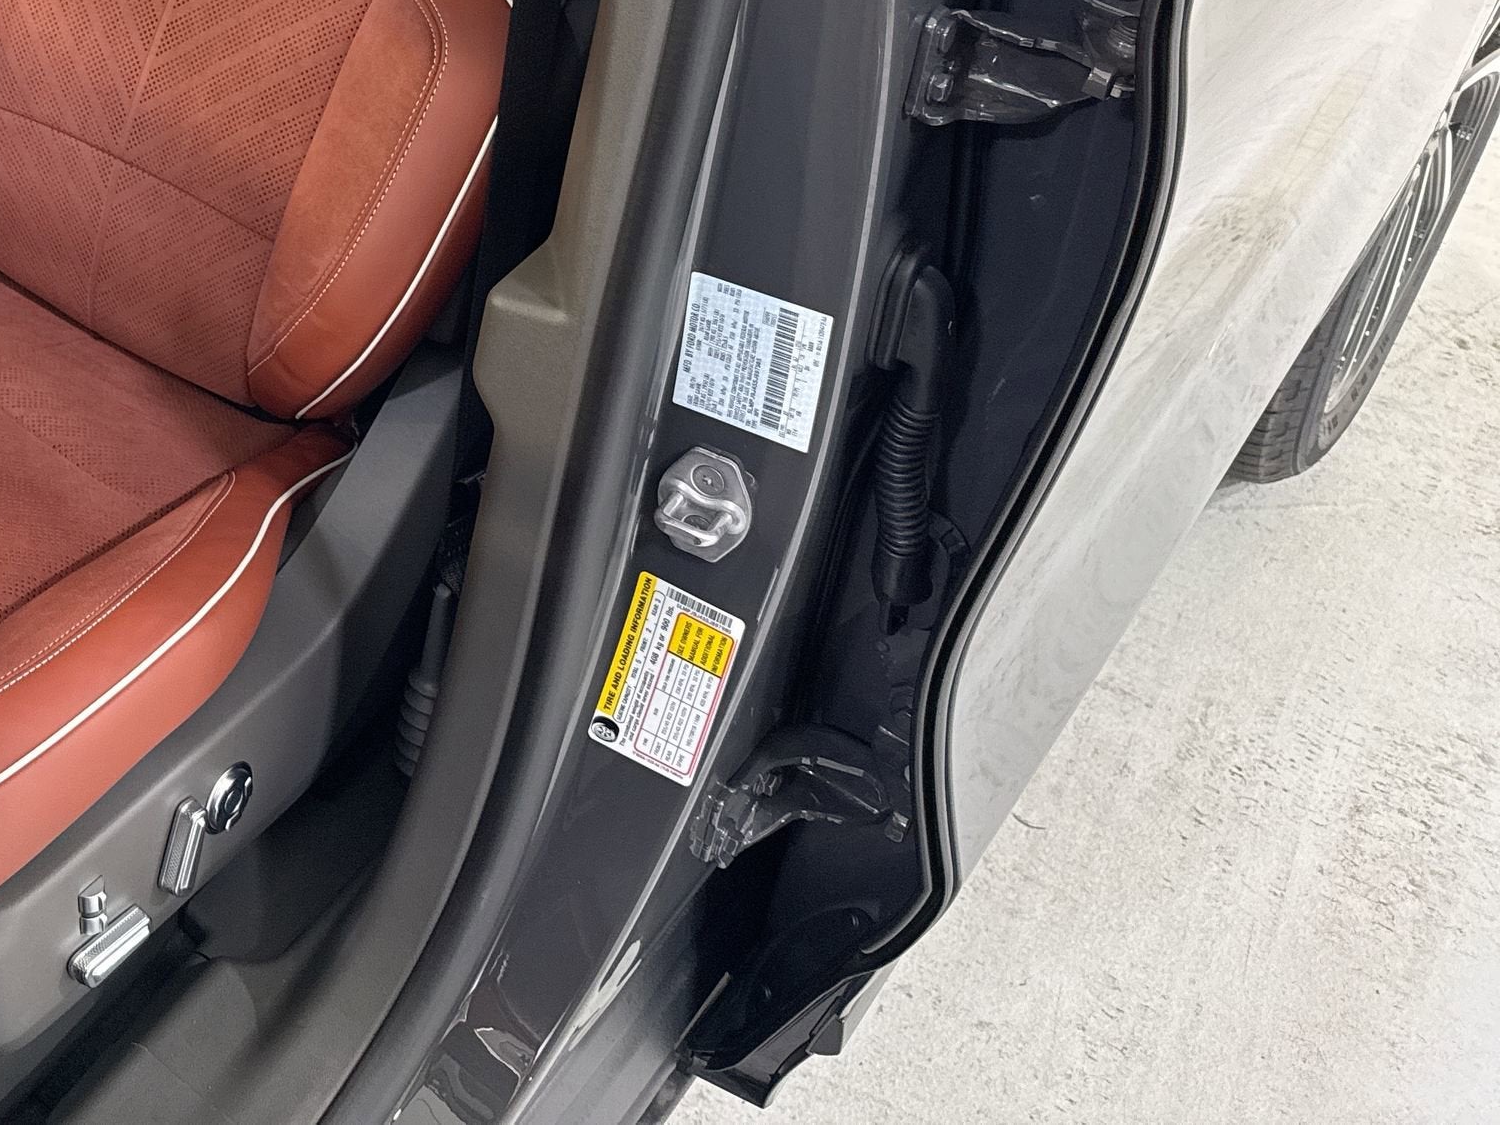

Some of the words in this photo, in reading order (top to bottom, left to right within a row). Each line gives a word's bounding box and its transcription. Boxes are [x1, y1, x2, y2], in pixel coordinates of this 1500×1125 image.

[689, 312, 699, 333] MOTOR
[686, 333, 696, 349] FORD
[685, 348, 693, 358] BY
[661, 618, 670, 631] 900
[695, 627, 704, 639] FOR
[604, 691, 615, 710] TIRE
[611, 672, 622, 690] AND
[618, 634, 635, 670] LOADING
[631, 577, 652, 633] INFORMATION
[654, 642, 664, 651] kg
[700, 635, 715, 666] ADDITIONAL
[650, 652, 659, 665] 408
[711, 637, 727, 673] INFORMATION
